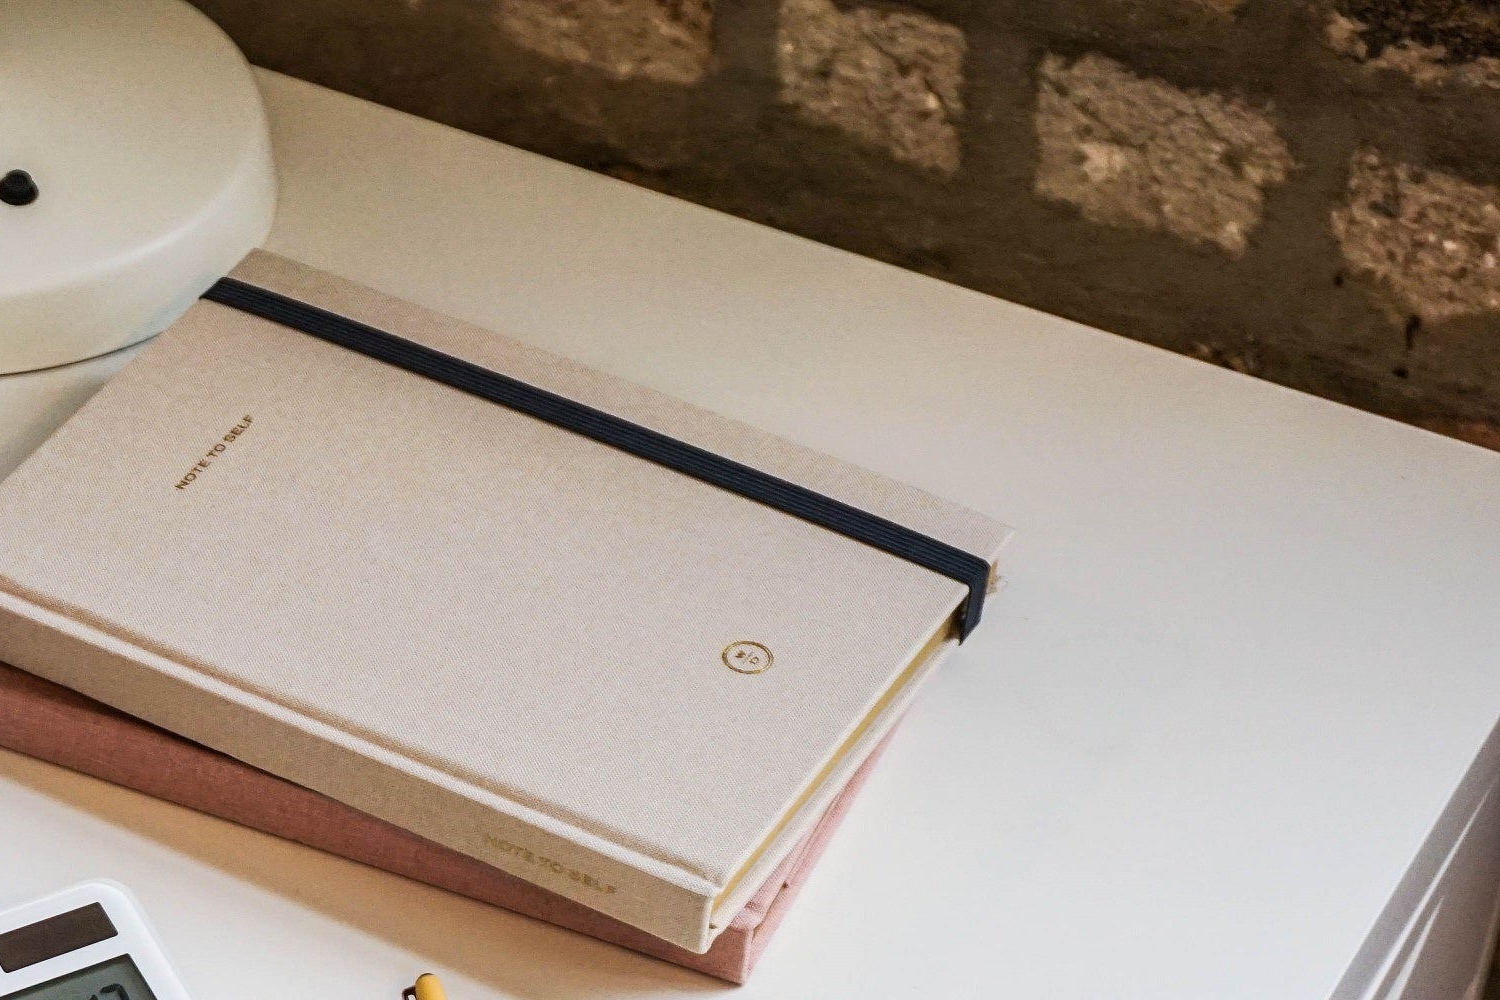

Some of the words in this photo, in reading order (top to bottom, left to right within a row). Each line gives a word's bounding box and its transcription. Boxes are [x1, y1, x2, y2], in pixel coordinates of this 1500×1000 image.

[175, 458, 212, 490] NOTE
[206, 443, 226, 458] TO
[223, 414, 253, 443] SELF
